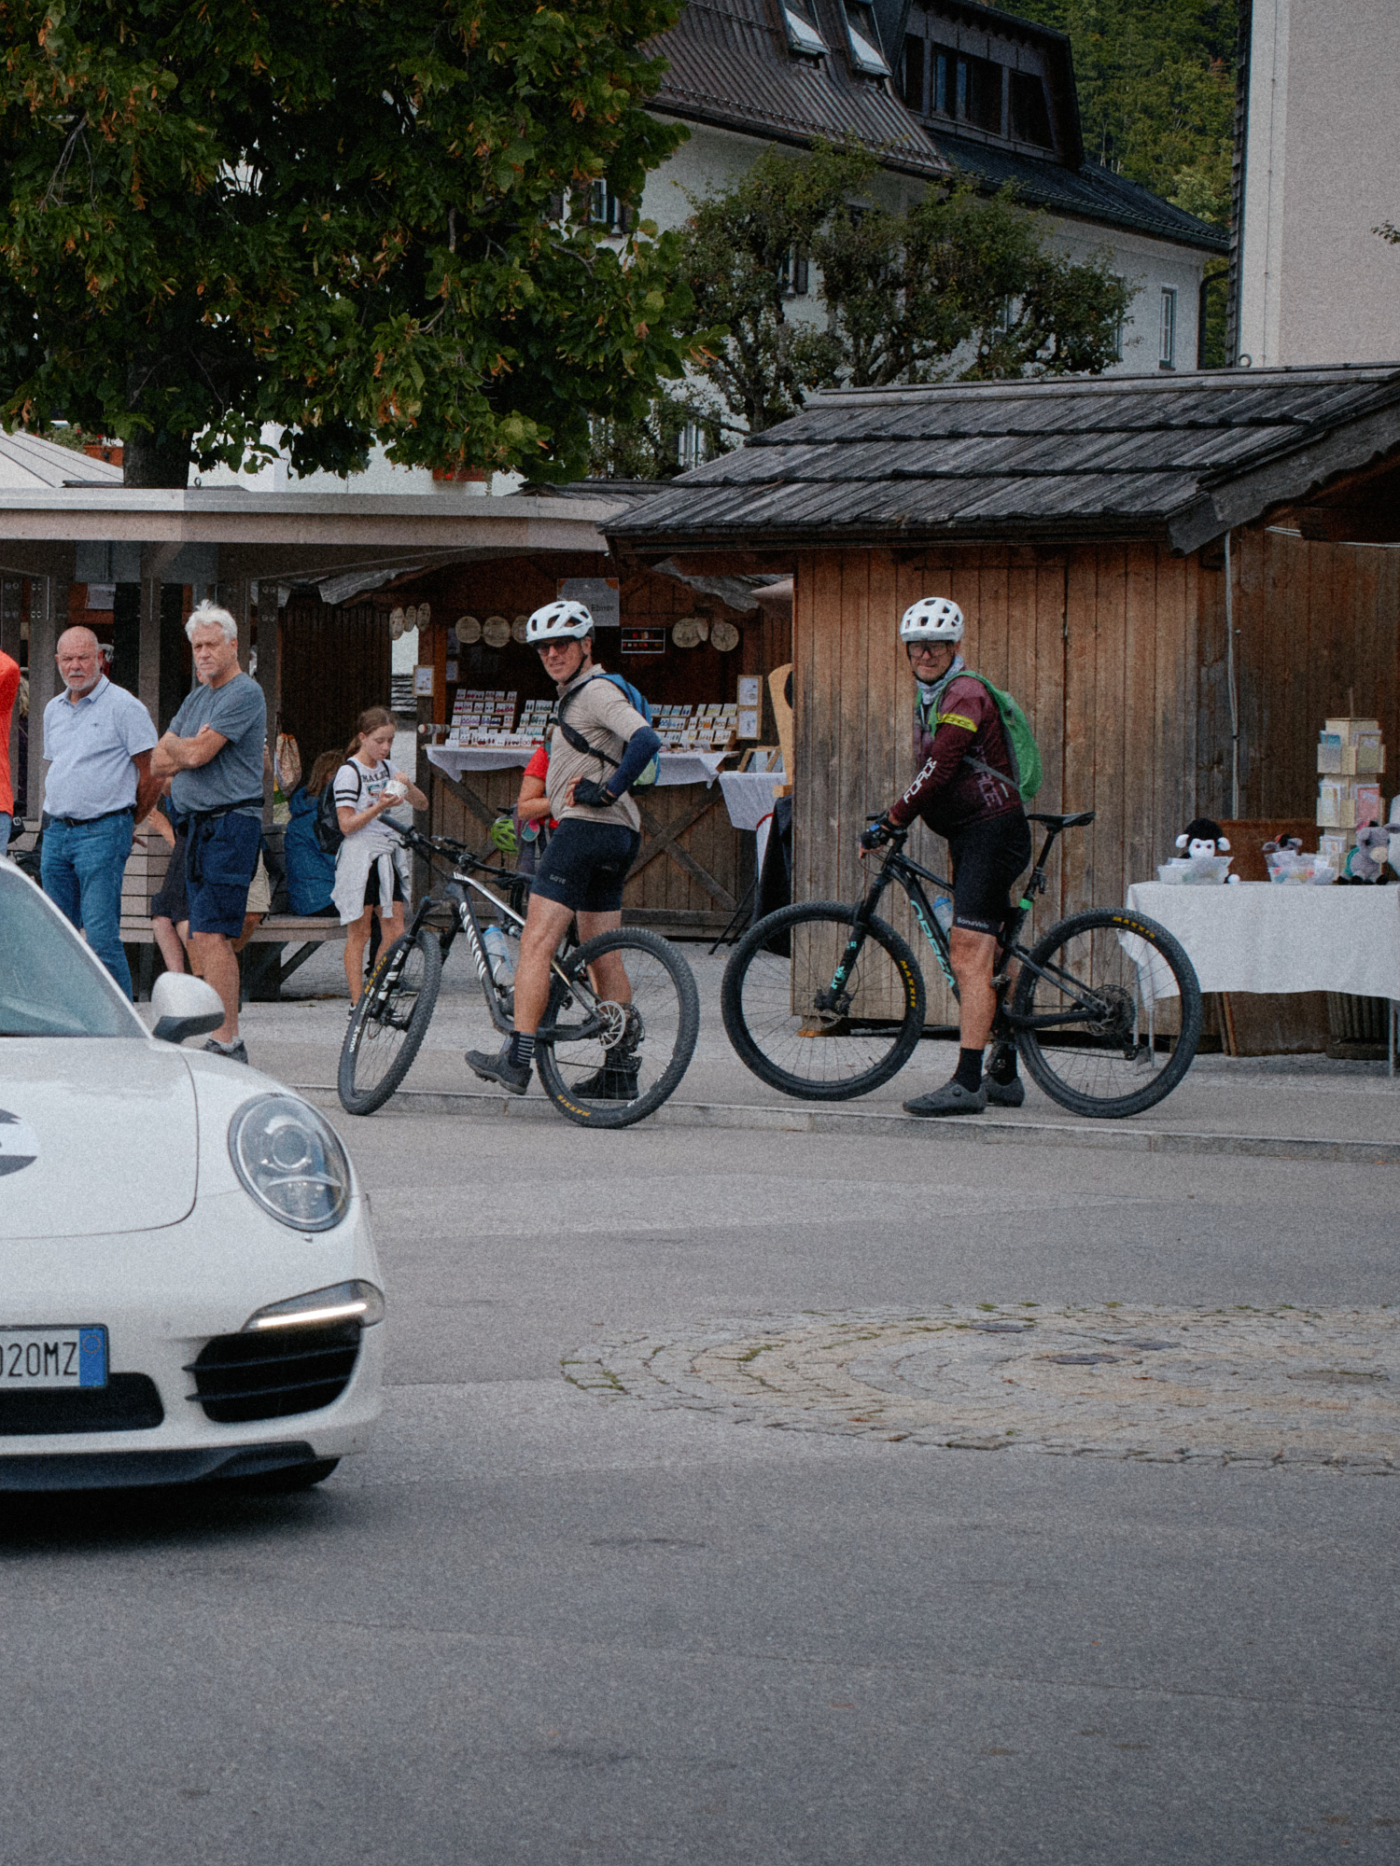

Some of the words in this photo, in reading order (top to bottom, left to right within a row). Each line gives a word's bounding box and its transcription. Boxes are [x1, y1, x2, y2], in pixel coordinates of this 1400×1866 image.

[459, 901, 488, 981] CANYON
[910, 899, 955, 988] ORBEA
[900, 960, 917, 1009] MAXXIS
